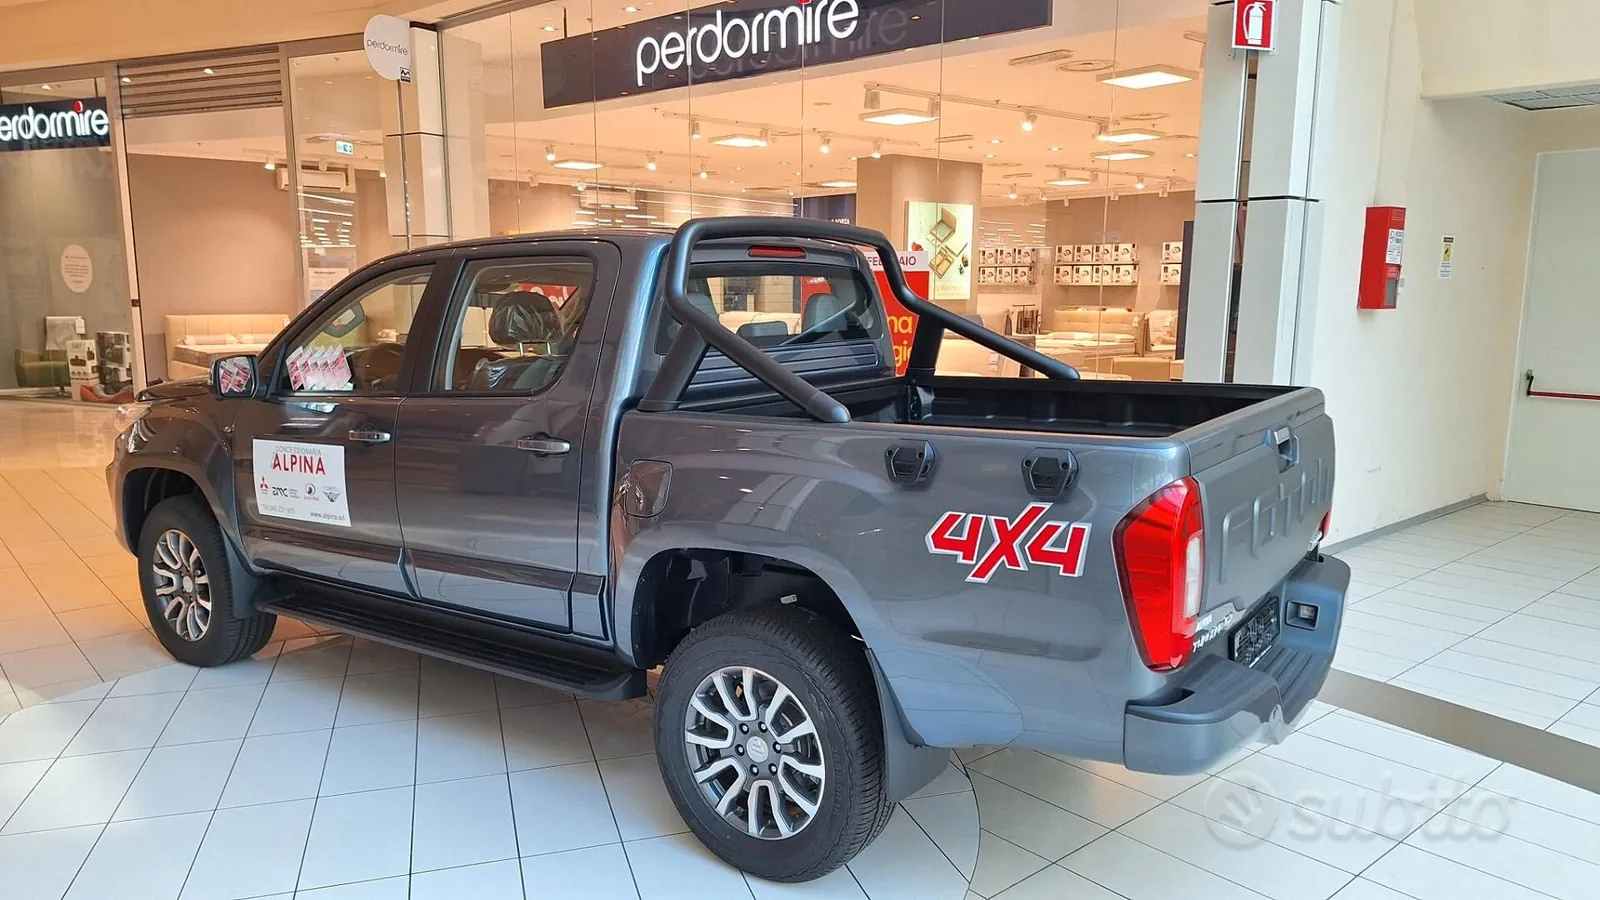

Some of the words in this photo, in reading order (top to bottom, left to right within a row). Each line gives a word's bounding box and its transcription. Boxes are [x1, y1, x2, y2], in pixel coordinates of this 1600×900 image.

[366, 39, 408, 56] perdormire
[636, 0, 859, 87] perdormire
[272, 453, 326, 475] ALPINA
